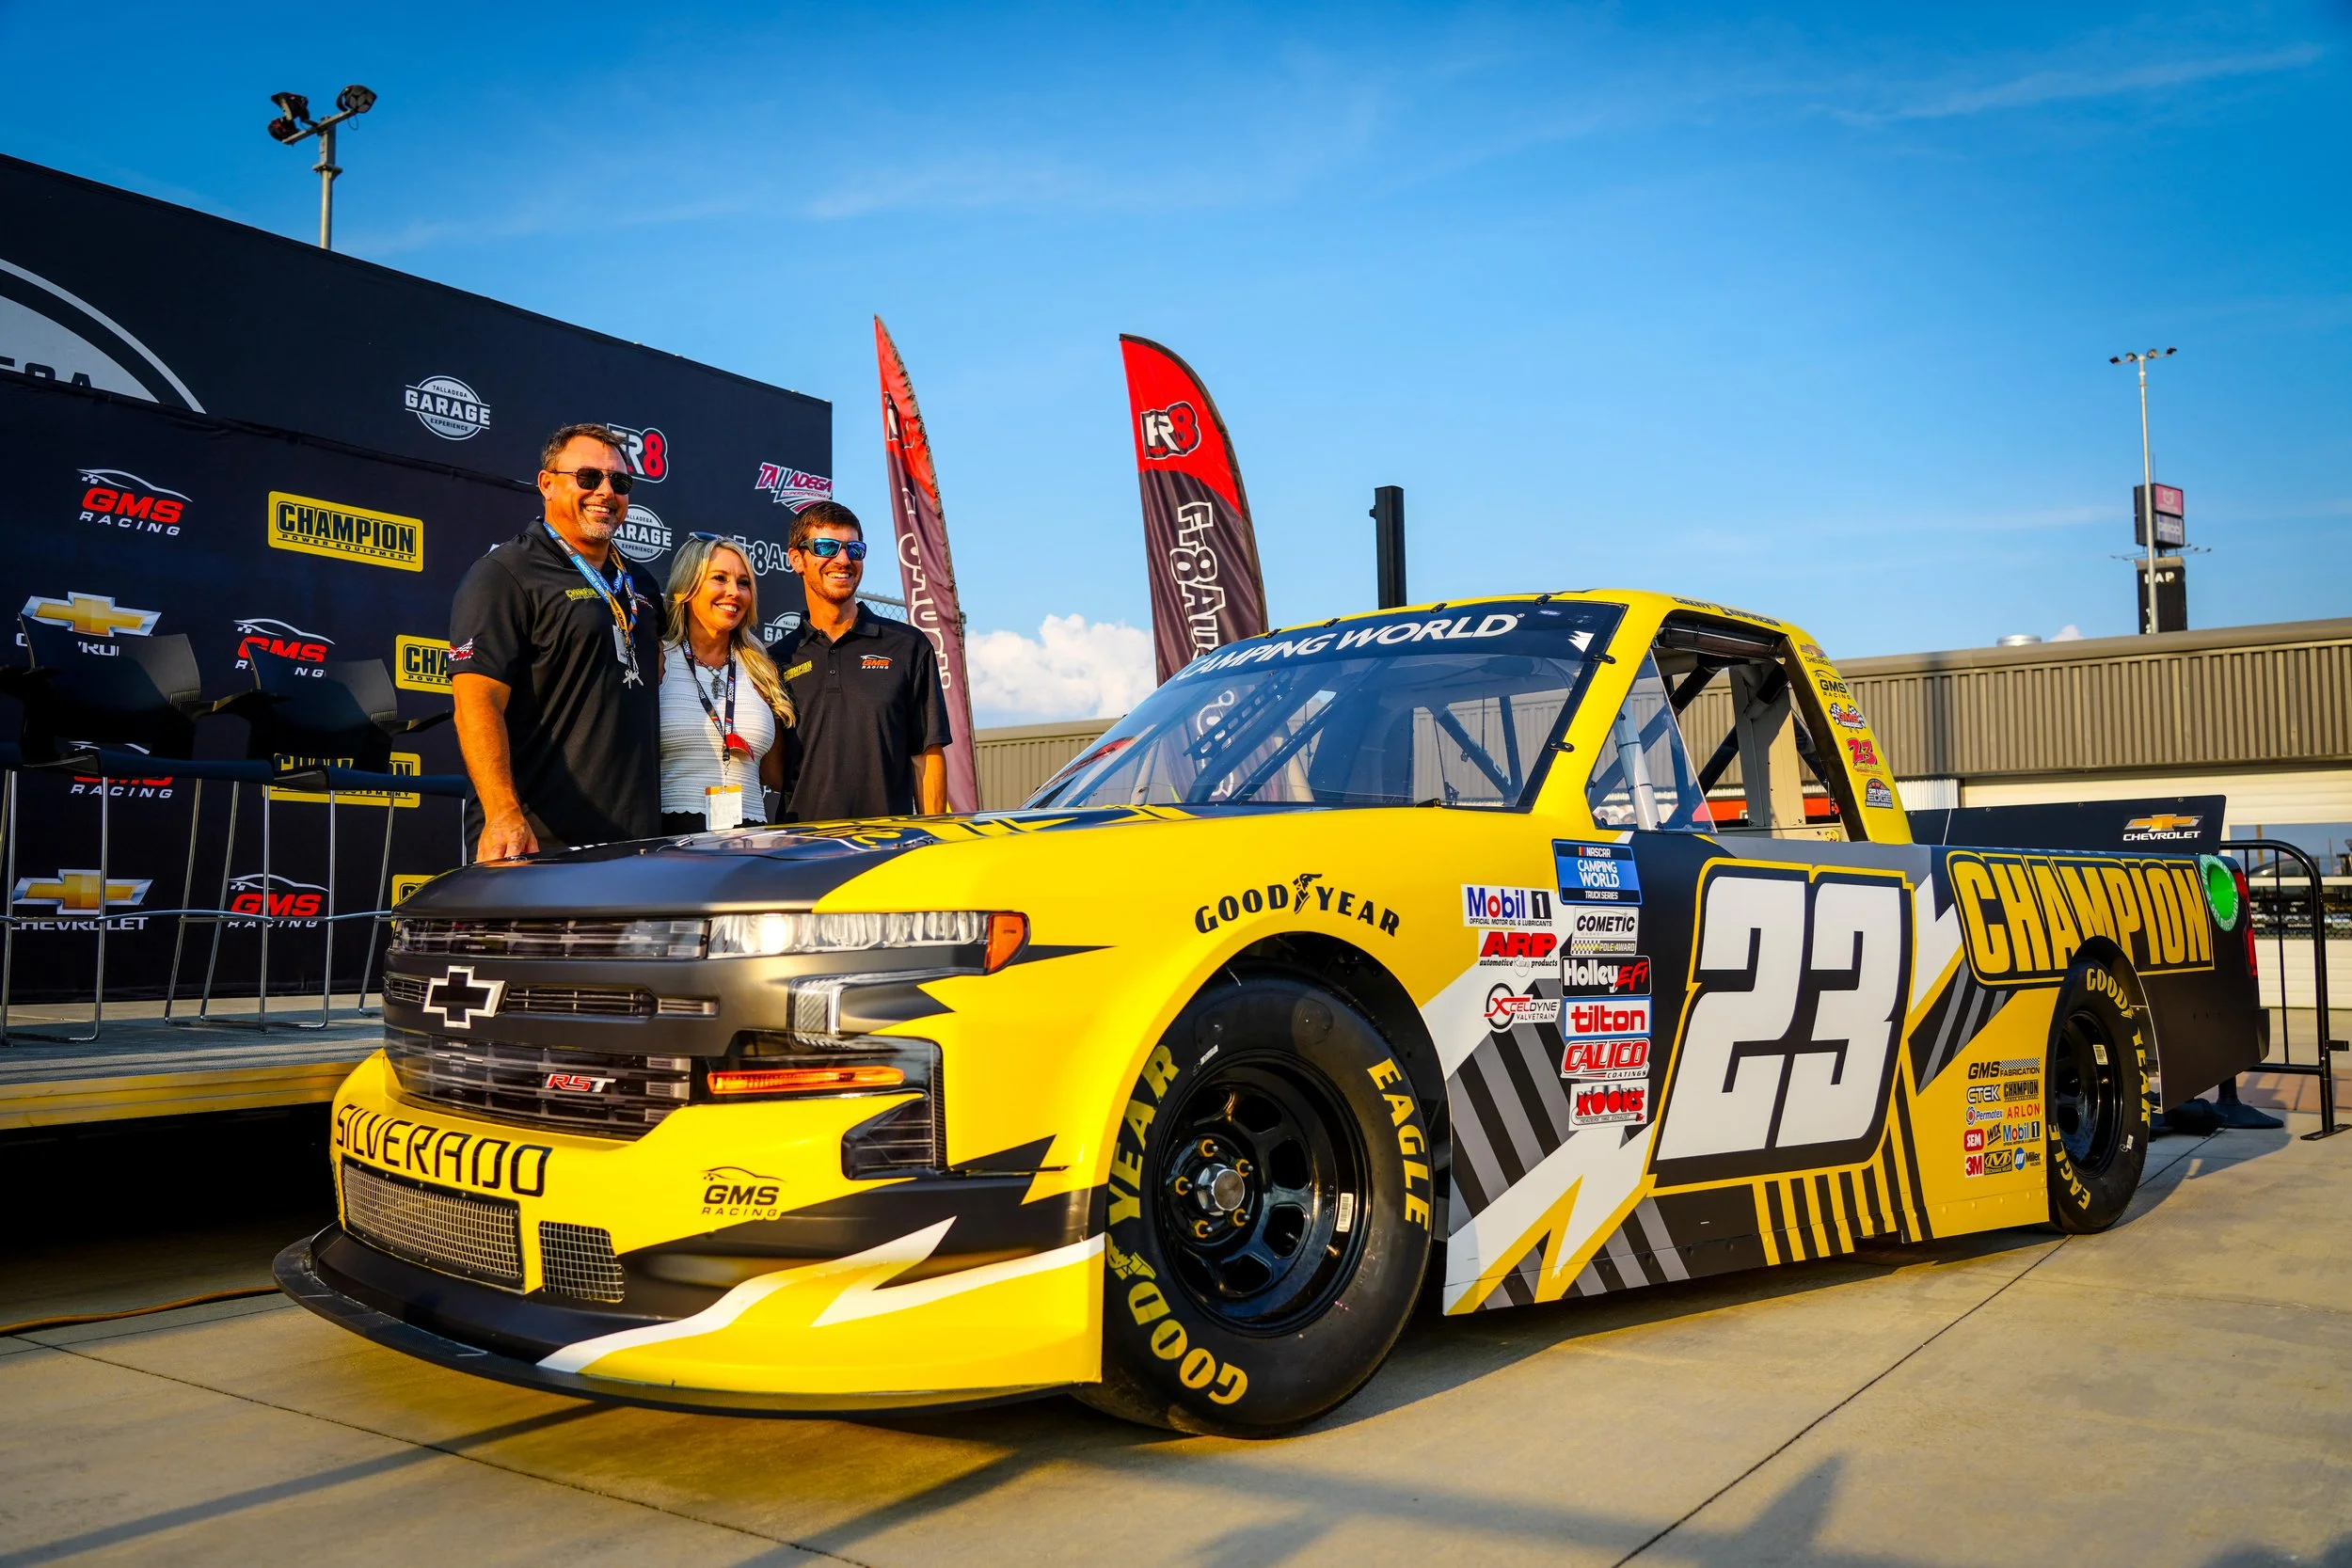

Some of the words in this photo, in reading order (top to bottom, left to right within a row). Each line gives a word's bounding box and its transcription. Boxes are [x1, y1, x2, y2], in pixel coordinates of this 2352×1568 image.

[432, 385, 469, 399] TALLADEGA
[405, 389, 491, 426] GARAGE
[430, 418, 469, 432] EXPERIENCE
[82, 486, 184, 524] GMS
[78, 511, 181, 536] RACING
[278, 502, 415, 555] CHAMPION
[627, 515, 653, 524] ALLADEGA
[613, 524, 673, 547] ARAGE
[281, 533, 329, 546] POWER
[336, 542, 413, 561] EQUIPMENT
[621, 543, 654, 554] EXPERIENCE
[1176, 632, 1341, 681] CAMPING
[1335, 613, 1518, 651] WORLD
[1820, 679, 1848, 694] GMS
[1822, 691, 1851, 701] RACING
[1847, 738, 1878, 765] 23
[71, 784, 173, 800] RACING
[1867, 794, 1892, 803] EDGE
[2122, 831, 2201, 842] CHEVROLET
[1586, 847, 1612, 858] NASCAR
[1577, 859, 1617, 874] CAMPING
[1579, 872, 1620, 889] WORLD
[230, 893, 323, 917] GMS
[1467, 886, 1526, 919] Mobil
[1584, 890, 1601, 899] TRUCK
[1601, 891, 1618, 900] SERIES
[1469, 917, 1490, 926] OFFICIAL
[1490, 918, 1508, 927] MOTOR
[1576, 914, 1636, 932] COMETIC
[1950, 858, 2212, 974] CHAMPION
[1479, 931, 1558, 958] ARP
[1599, 942, 1614, 952] POLE
[1614, 942, 1635, 952] AWARD
[1479, 959, 1514, 968] automotive
[1531, 958, 1558, 969] products
[1564, 959, 1619, 993] Holley
[1516, 1012, 1555, 1021] VALVETRAIN
[1570, 1005, 1645, 1034] tilton
[1656, 875, 1902, 1162] 23
[1564, 1040, 1648, 1072] CALICO
[1606, 1069, 1646, 1079] COATINGS
[1967, 1060, 2001, 1080] GMS
[1999, 1066, 2041, 1078] FABRICATION
[544, 1073, 617, 1093] RST
[2004, 1080, 2039, 1099] CHAMPION
[1576, 1088, 1645, 1117] KOOKS
[1966, 1084, 2002, 1104] CTEK
[2007, 1103, 2041, 1119] ARLON
[1966, 1132, 1982, 1148] SEM
[1987, 1122, 2001, 1142] WIX
[2003, 1121, 2029, 1143] Mobil
[336, 1102, 554, 1197] SILVERADO
[1366, 1057, 1432, 1231] EAGLE
[1965, 1155, 1983, 1177] 3M
[703, 1184, 780, 1206] GMS
[701, 1207, 778, 1217] RACING
